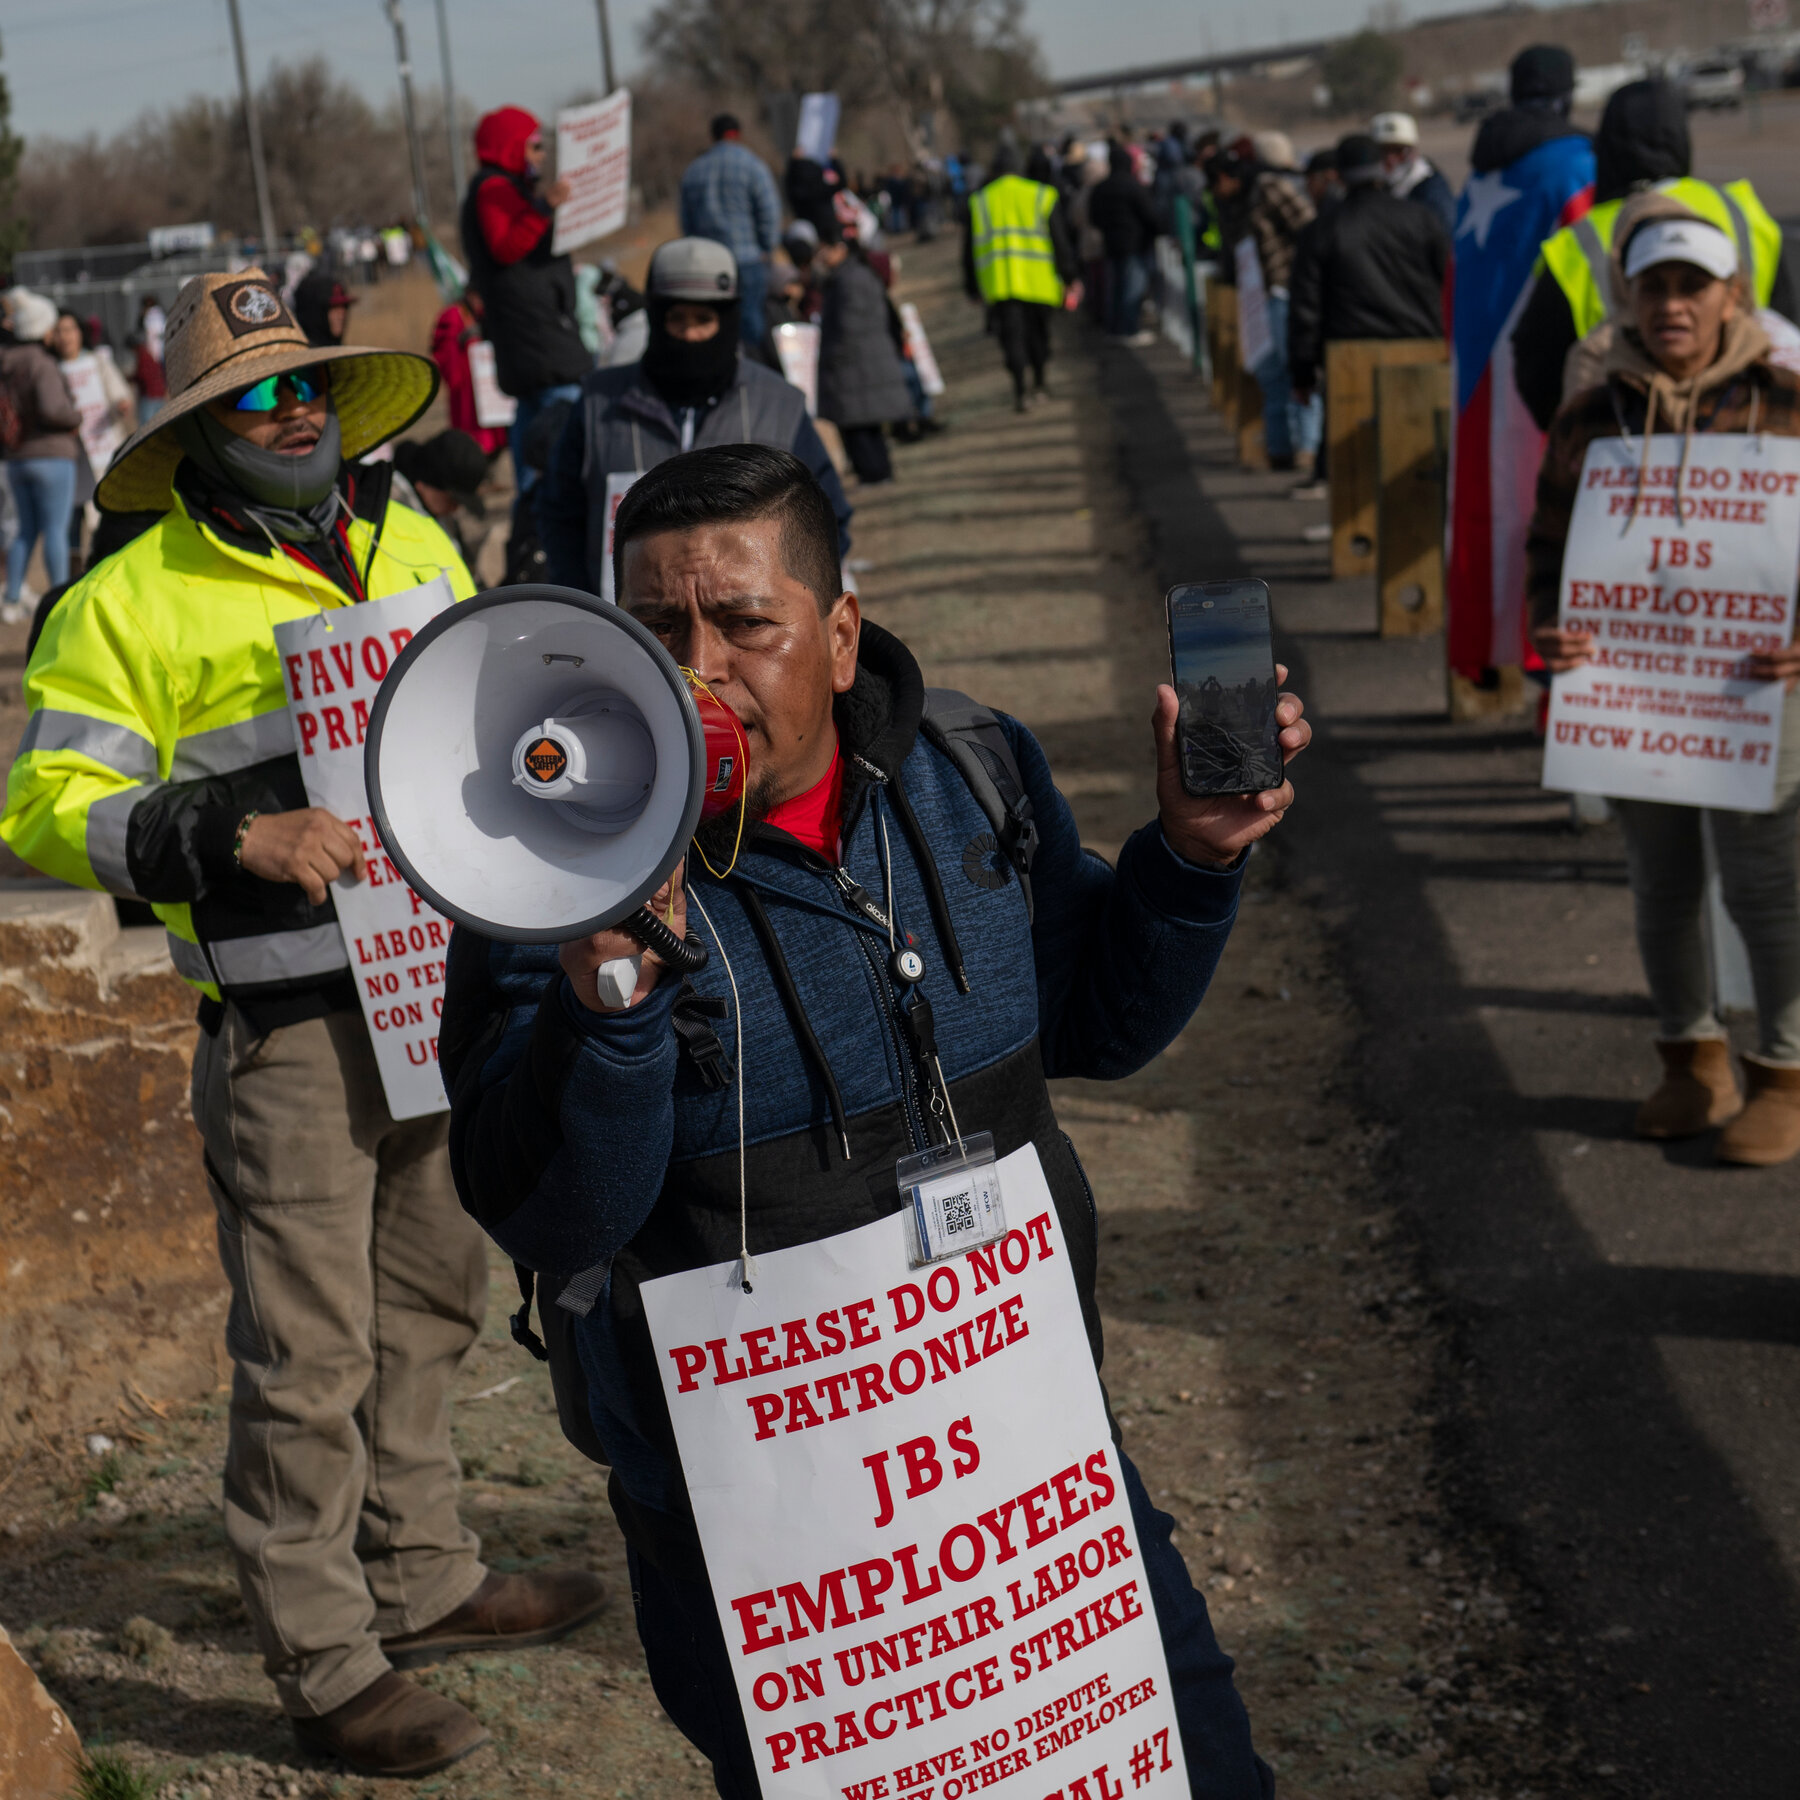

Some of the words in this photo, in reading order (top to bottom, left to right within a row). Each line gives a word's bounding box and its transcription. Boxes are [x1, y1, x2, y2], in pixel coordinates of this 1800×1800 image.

[1690, 467, 1731, 490] DO
[1738, 469, 1799, 495] NOT
[1649, 537, 1712, 573] JBS
[1569, 580, 1787, 624] EMPLOYEES
[1587, 647, 1686, 675] ACTICE
[1609, 619, 1695, 647] UNFAIR
[1703, 628, 1783, 653] LABOR
[297, 696, 377, 757] PRA
[1554, 721, 1633, 749] UFCW
[1641, 730, 1735, 762] LOCAL
[1741, 741, 1772, 766] #7
[365, 972, 400, 998] NO
[373, 1002, 423, 1031] CON
[670, 1298, 880, 1392] PLEASE
[887, 1267, 959, 1332] DO
[966, 1212, 1053, 1295] NOT
[747, 1294, 1029, 1440] PATRONIZE
[863, 1416, 980, 1527] JBS
[731, 1450, 1116, 1655] EMPLOYEES
[752, 1664, 824, 1712] ON
[834, 1596, 1003, 1686] UNFAIR
[1007, 1525, 1132, 1620] LABOR
[765, 1656, 1004, 1772] PRACTICE
[1011, 1580, 1143, 1683] STRIKE
[893, 1746, 967, 1791] HAVE
[970, 1728, 1009, 1762] NO
[1014, 1673, 1111, 1741] DISPUTE
[943, 1747, 1032, 1800] OTHER
[1034, 1678, 1157, 1760] EMPLOYER
[1128, 1727, 1173, 1790] #7
